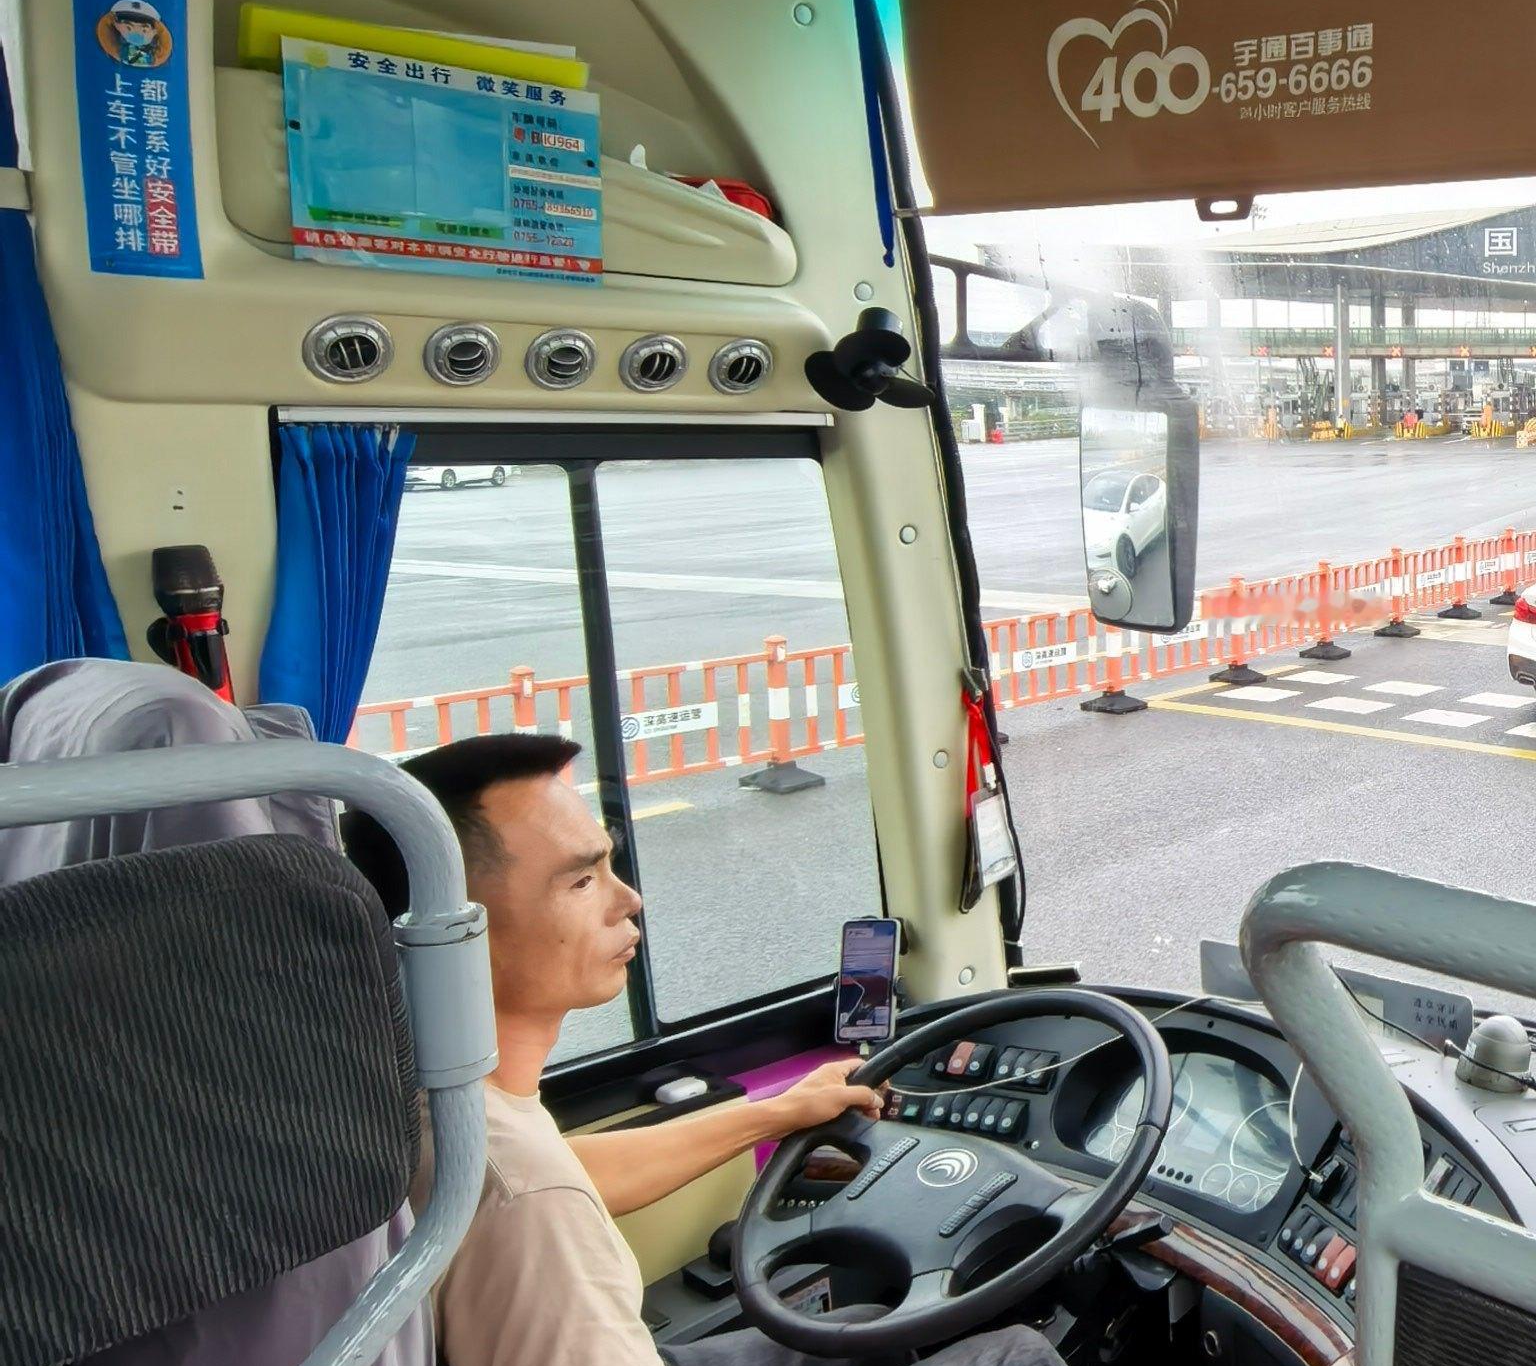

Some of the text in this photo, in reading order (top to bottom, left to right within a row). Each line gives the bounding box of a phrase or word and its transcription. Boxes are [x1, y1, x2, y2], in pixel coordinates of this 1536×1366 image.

[347, 50, 568, 107] 安全出行 微笑服务
[1233, 22, 1374, 67] 宇通百事通
[104, 72, 146, 252] 上车不管坐哪排
[140, 78, 179, 255] 都要系好安全带
